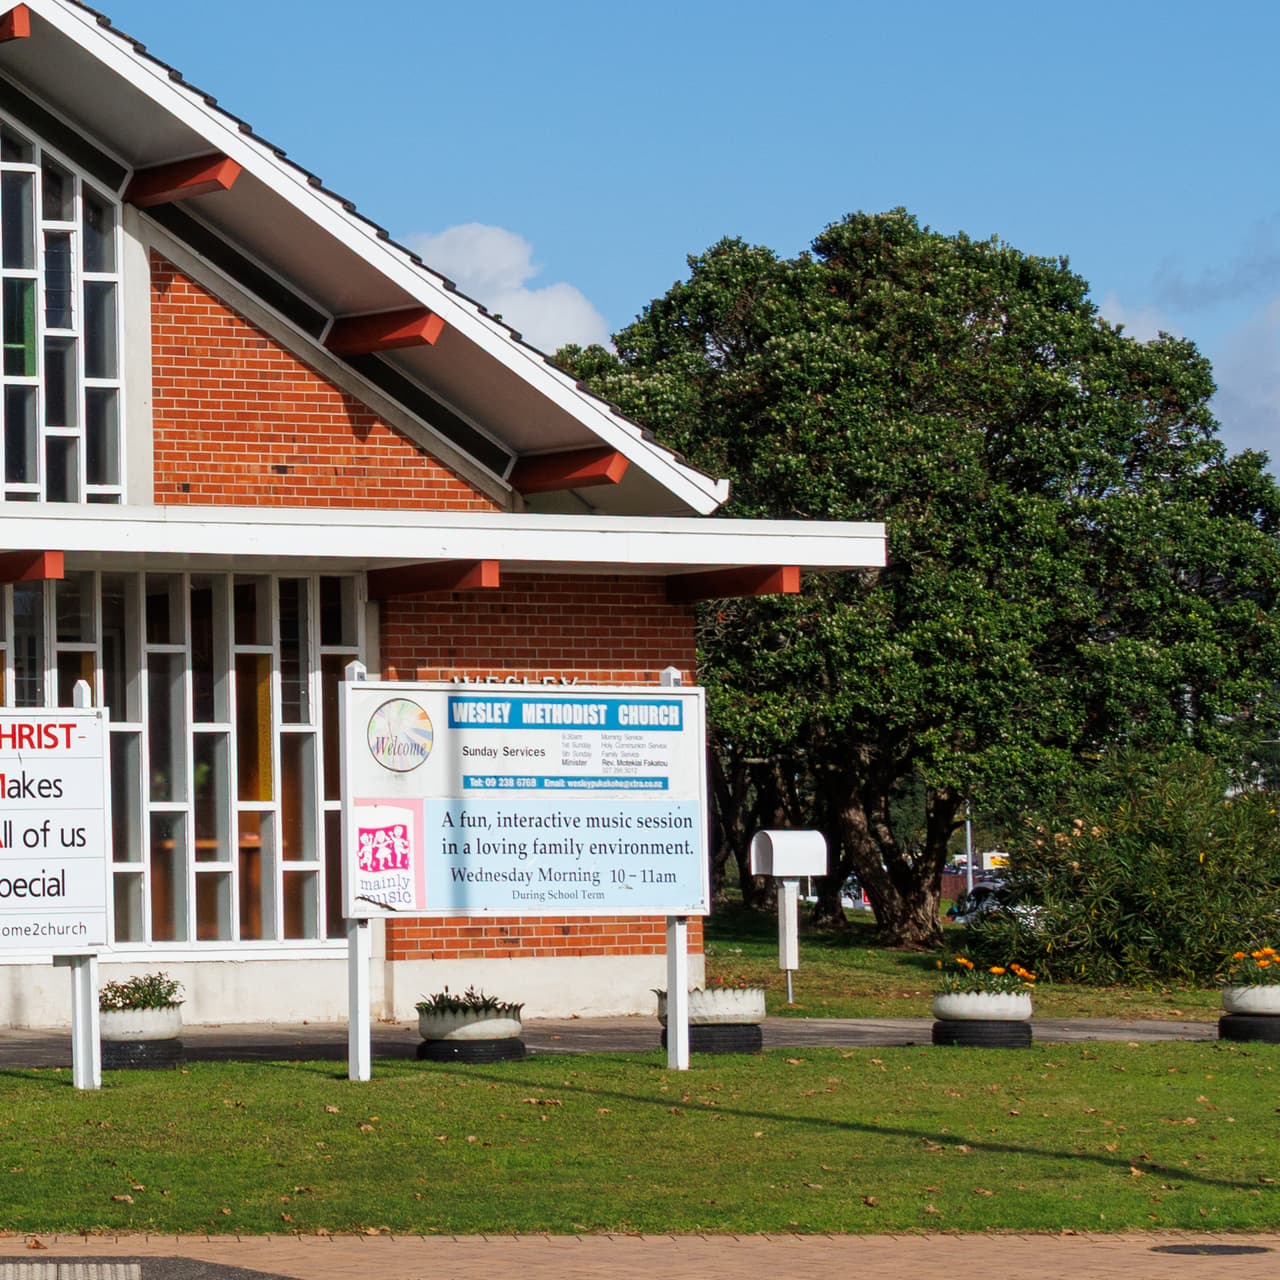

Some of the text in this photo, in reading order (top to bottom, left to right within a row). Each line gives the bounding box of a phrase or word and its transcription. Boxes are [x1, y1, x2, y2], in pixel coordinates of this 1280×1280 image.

[452, 702, 679, 726] WESLEY METHODIST CHURCH
[376, 736, 427, 756] Welcome
[462, 746, 546, 759] Sunday Services
[469, 777, 484, 787] Tel:
[485, 777, 496, 787] 09
[498, 778, 514, 787] 238
[544, 778, 565, 788] Email:
[442, 810, 693, 832] A fun, interactive music session
[23, 820, 50, 848] of
[61, 827, 87, 848] us
[442, 837, 694, 860] in a loving family environment.
[360, 874, 410, 890] mainly
[451, 866, 533, 885] Wednesday
[538, 867, 601, 886] Morning
[610, 868, 625, 883] 10
[641, 868, 677, 883] 11am
[512, 889, 605, 901] During School Term
